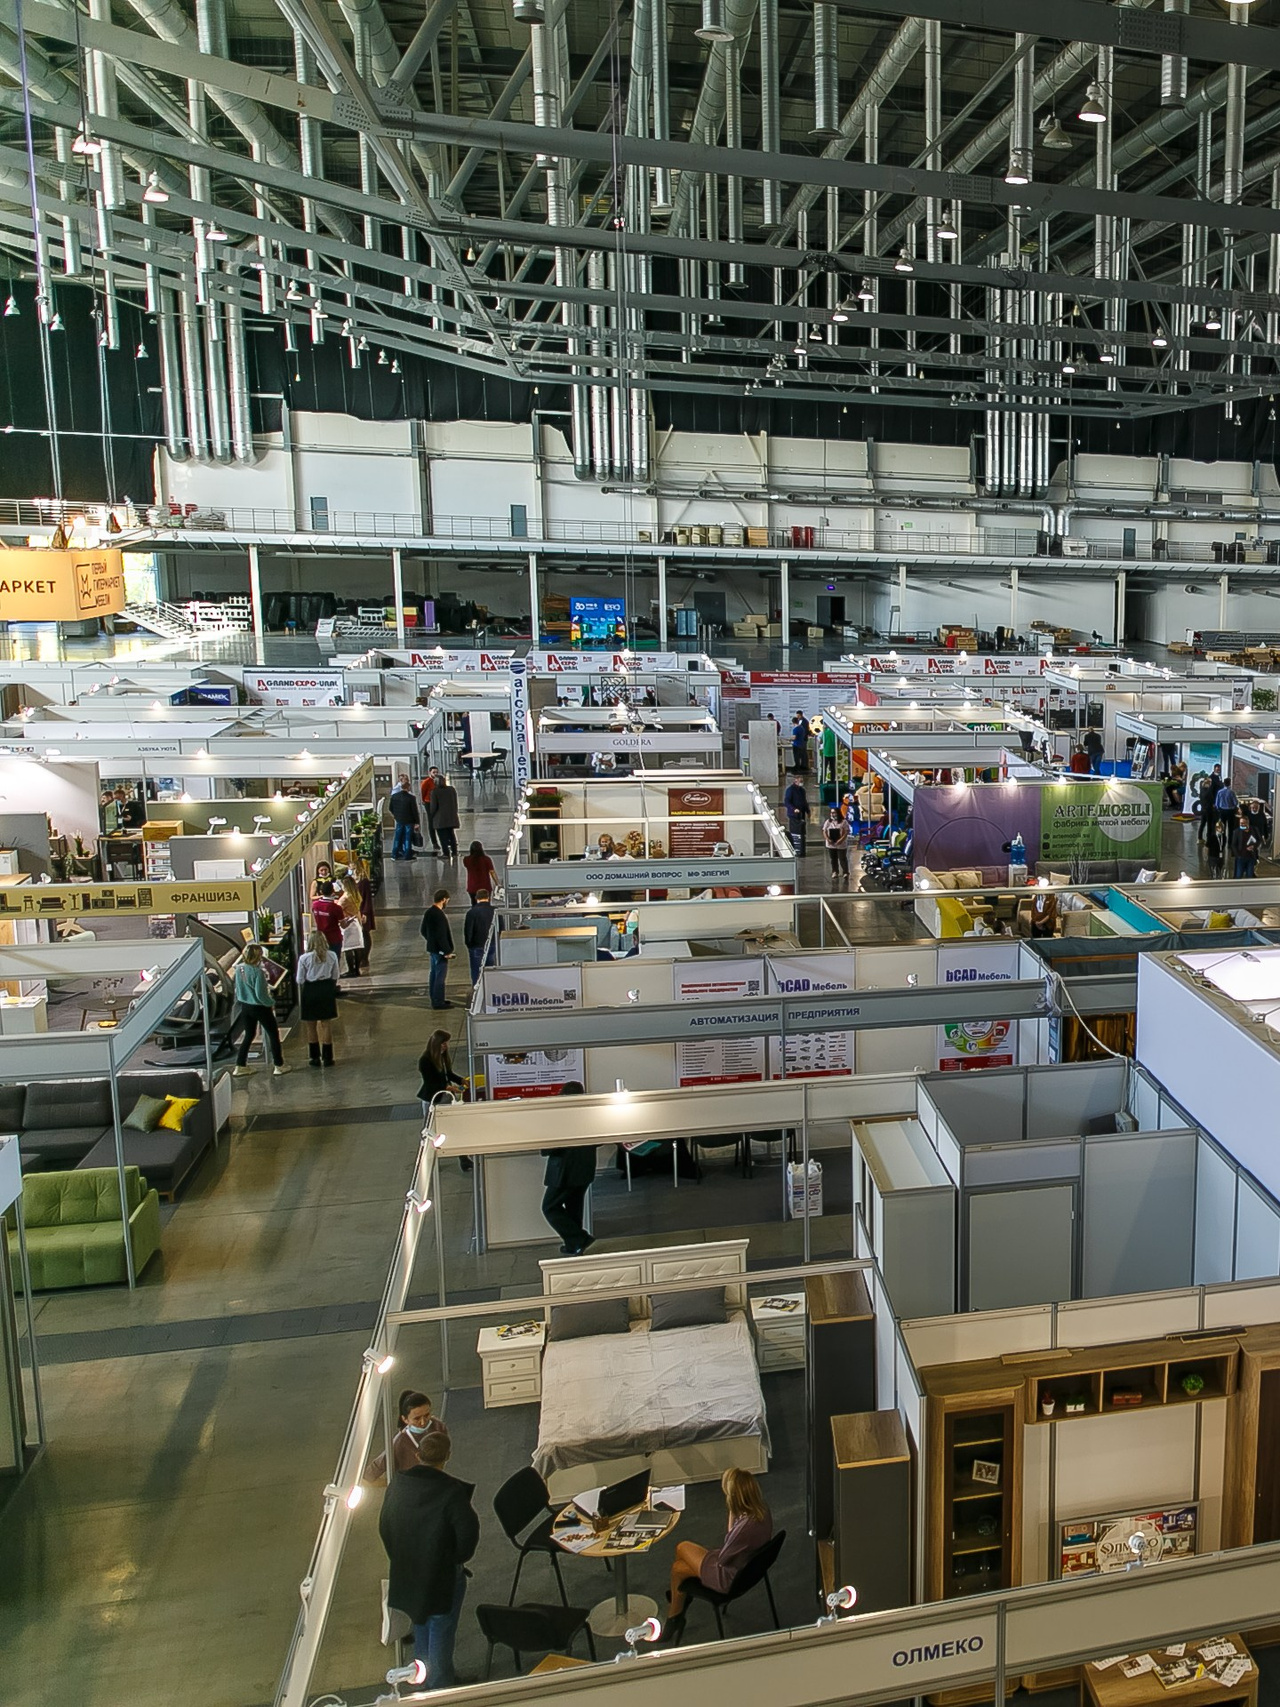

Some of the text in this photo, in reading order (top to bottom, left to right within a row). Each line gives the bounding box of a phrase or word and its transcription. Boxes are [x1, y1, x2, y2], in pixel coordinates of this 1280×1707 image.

[91, 558, 107, 575] ПЕРВЫЙ
[93, 576, 120, 592] ГИПЕРМАРКЕТ
[612, 738, 652, 747] GOLDERA
[1053, 817, 1150, 829] фабрика мягкой мебели
[586, 869, 730, 881] ООО ДОМАШНИЙ ВОПРОС МФ ЭЛЕГИЯ
[171, 891, 241, 903] ФРАНШИЗА
[945, 968, 1011, 982] bCAD Мебель
[812, 982, 848, 991] Мебель
[491, 992, 564, 1007] bCAD Мебель
[689, 1007, 860, 1027] АВТОМАТИЗАЦИЯ ПРЕДПРИЯТИЯ
[1108, 1537, 1159, 1554] ОЛМО
[892, 1636, 984, 1667] ОЛМЕКО
